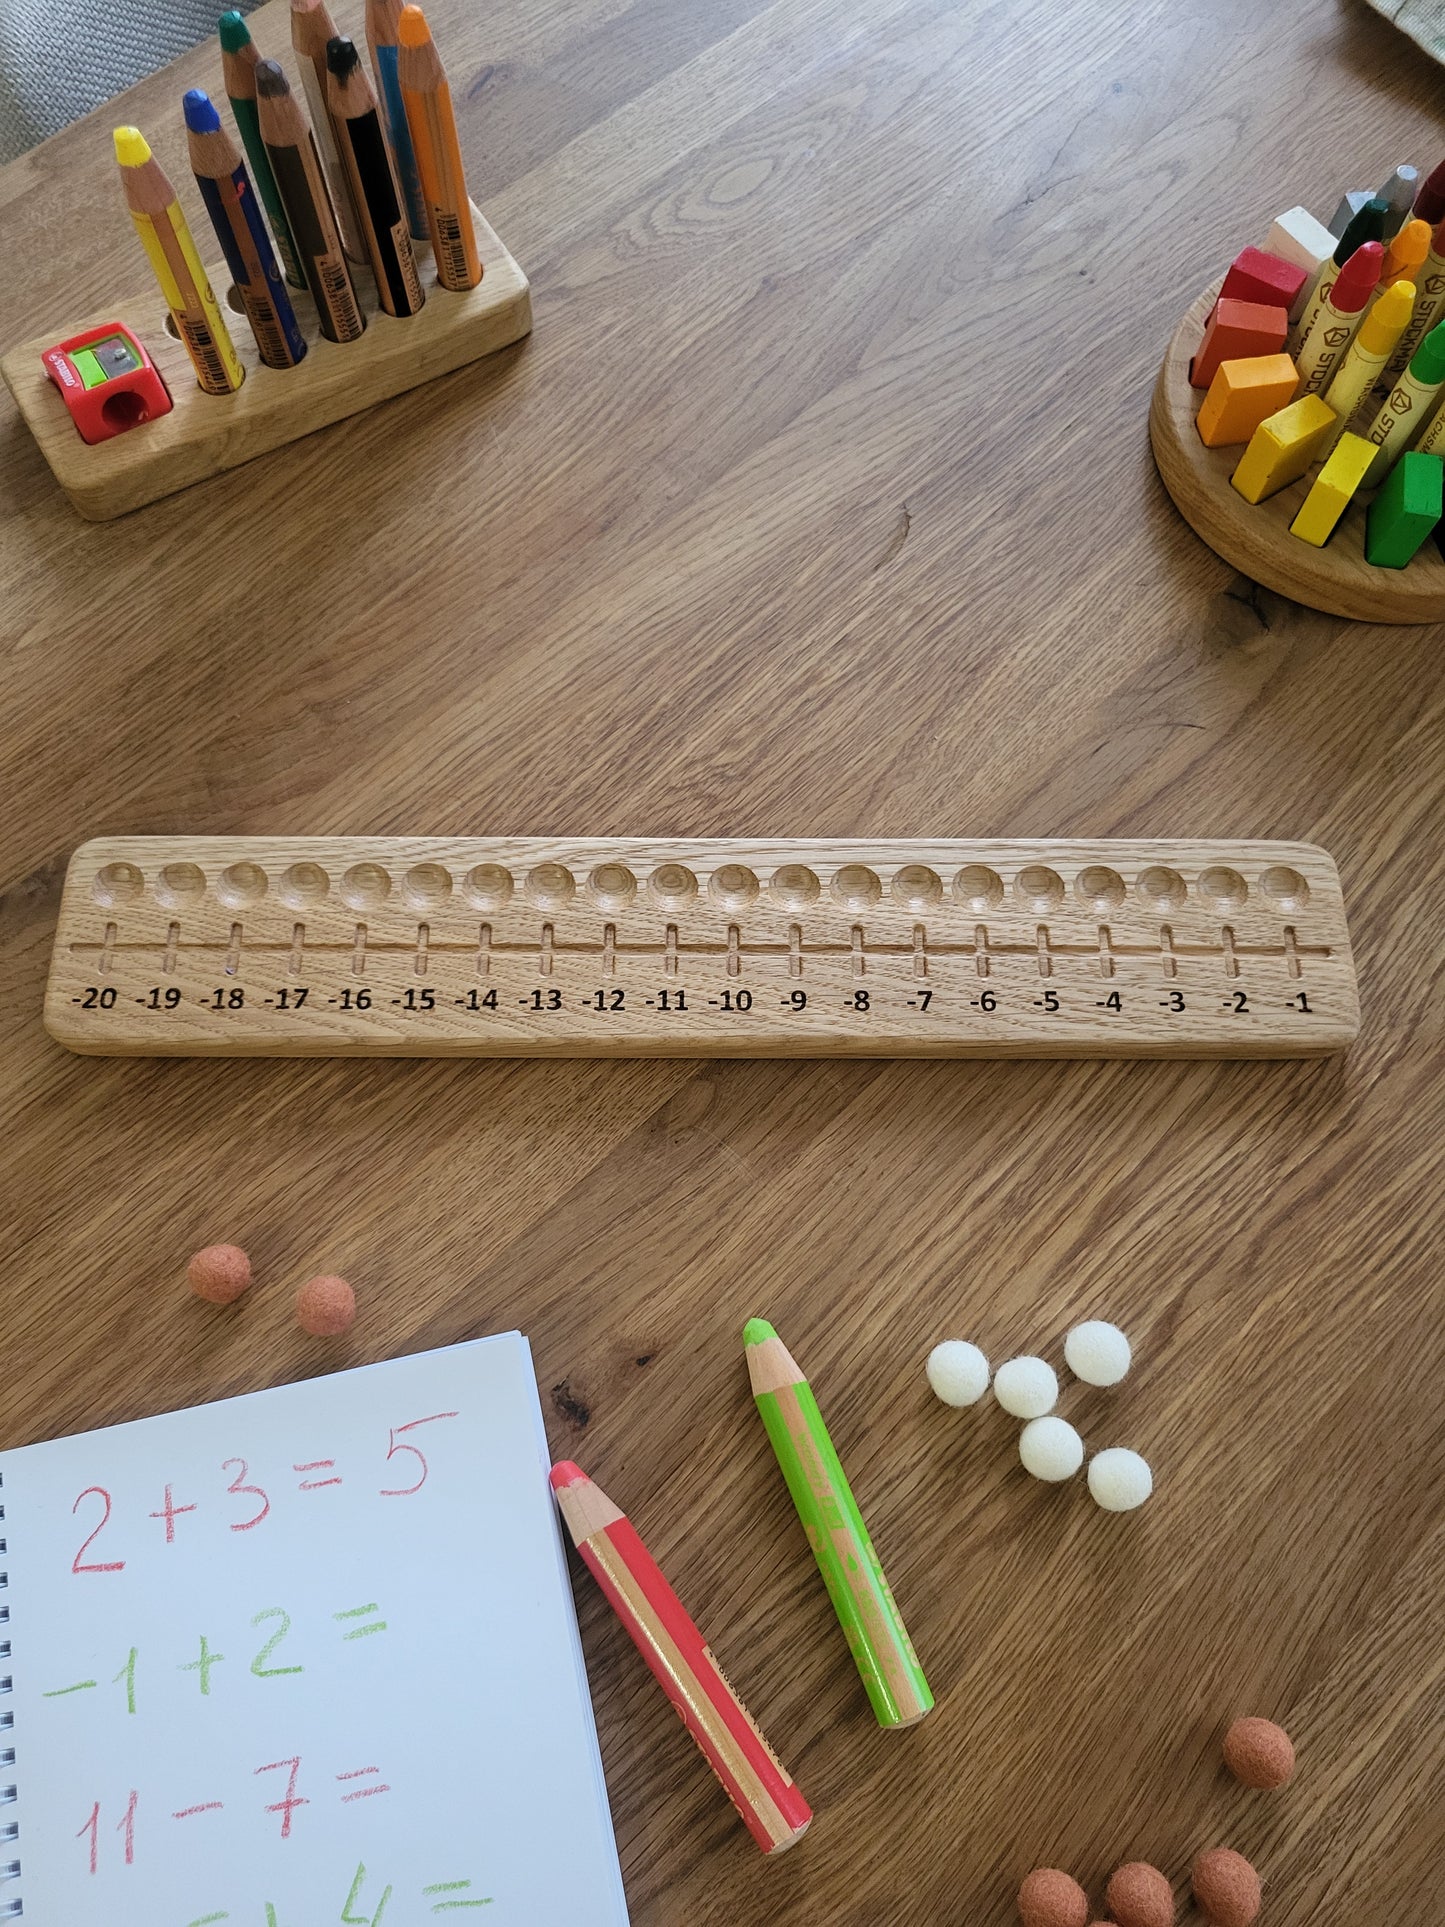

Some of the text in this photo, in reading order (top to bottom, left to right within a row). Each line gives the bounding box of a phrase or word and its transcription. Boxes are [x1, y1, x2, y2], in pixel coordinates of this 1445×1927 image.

[54, 359, 76, 387] STABILO
[71, 987, 1314, 1014] -20 -19 -18 -17 -16 -15 -14 -13 -12 -11 -10 -9 -8 -7 -6 -5 -4 -3 -2 -1
[72, 1411, 459, 1574] 2 + 3 = 5
[177, 1635, 225, 1695] +
[250, 1606, 304, 1677] 2
[333, 1602, 388, 1641] =
[75, 1790, 138, 1874] 11
[253, 1756, 310, 1839] 7
[336, 1766, 391, 1803] =
[341, 1861, 494, 1927] 4 =
